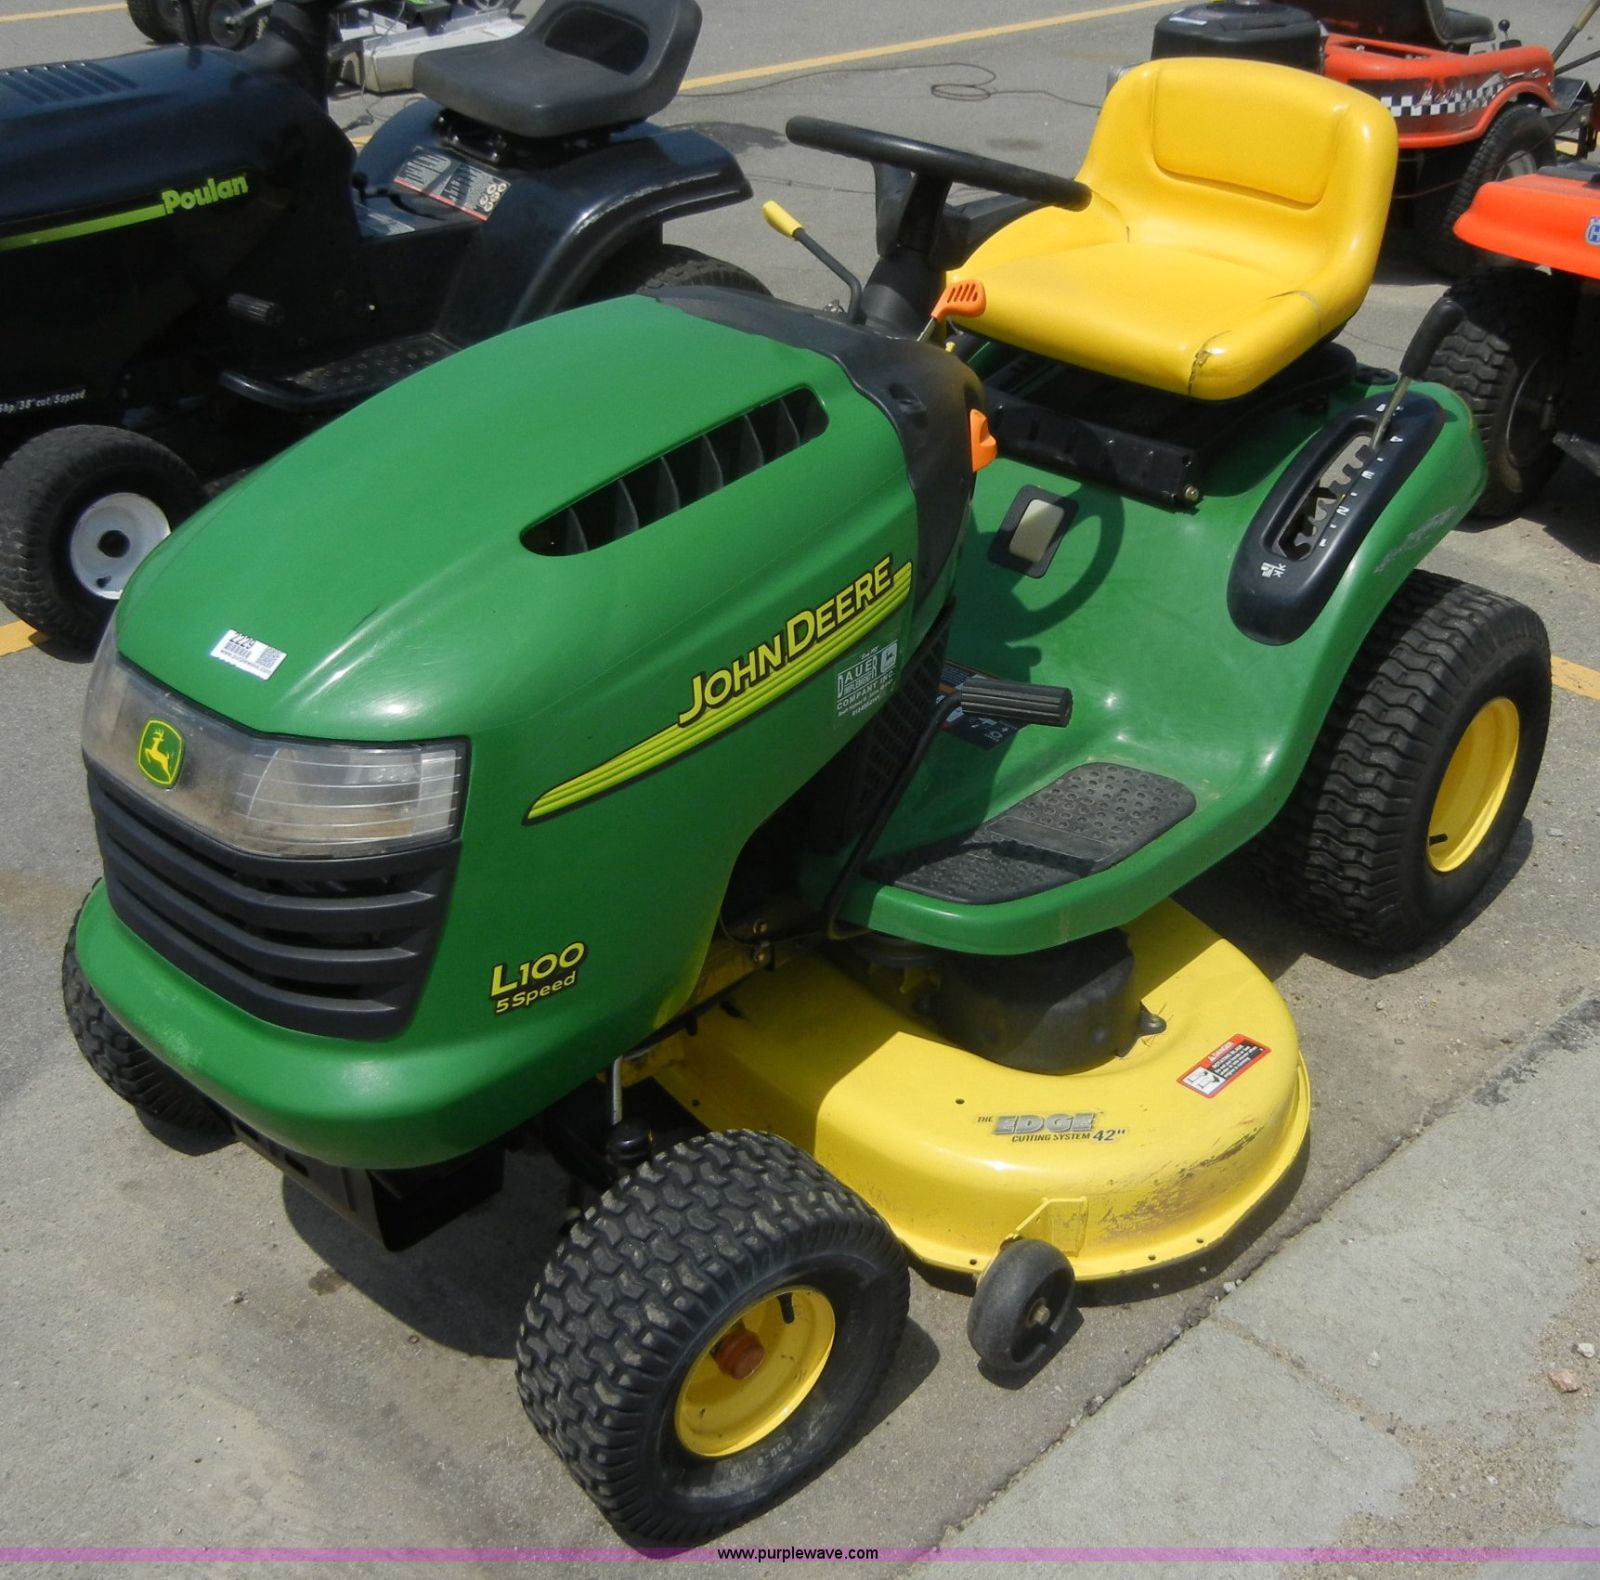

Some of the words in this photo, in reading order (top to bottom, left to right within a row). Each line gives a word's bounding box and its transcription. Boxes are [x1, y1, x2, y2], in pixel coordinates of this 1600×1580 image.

[161, 175, 249, 215] Poulan
[678, 632, 784, 727] JOHN
[785, 553, 894, 663] DEERE
[490, 941, 585, 997] L100
[495, 997, 510, 1014] 5
[511, 970, 577, 1007] Speed
[993, 1112, 1096, 1136] EDGE
[1053, 1132, 1091, 1142] SYSTEM
[1092, 1129, 1126, 1142] 42"
